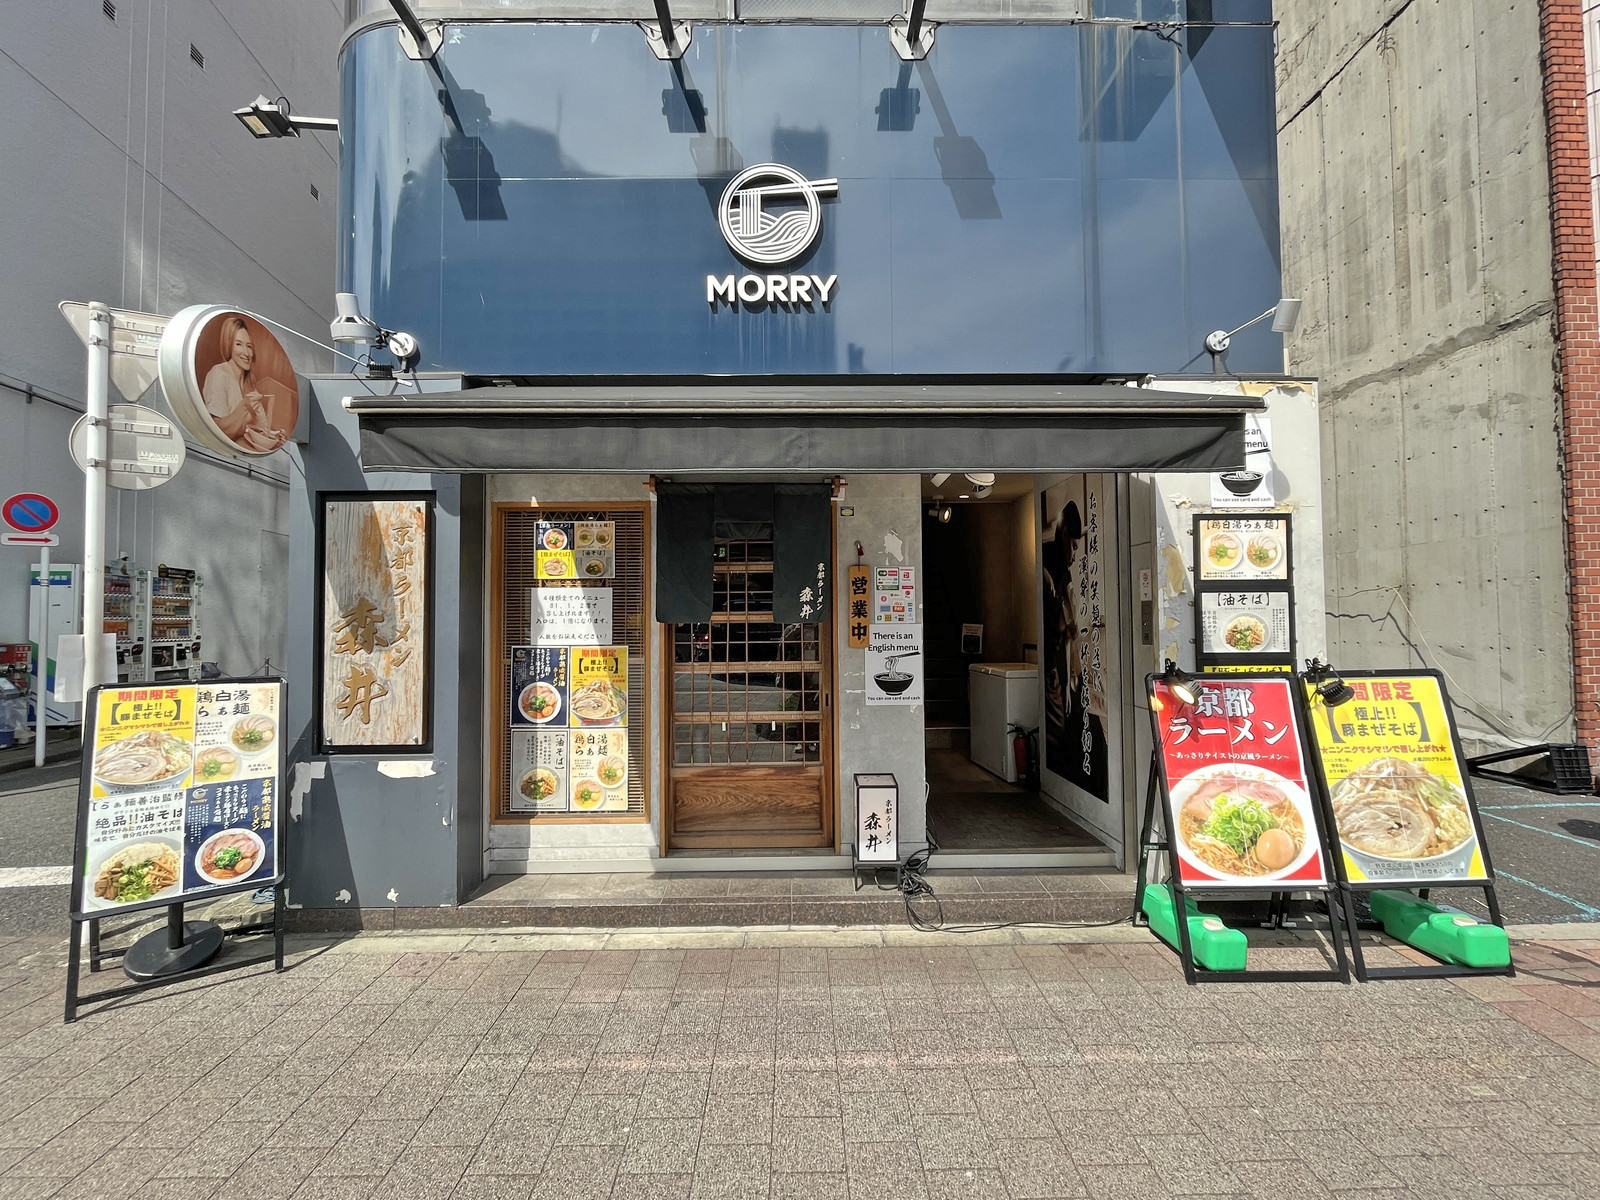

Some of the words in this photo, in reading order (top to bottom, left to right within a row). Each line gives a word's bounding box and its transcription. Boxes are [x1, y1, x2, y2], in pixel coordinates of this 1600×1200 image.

[706, 274, 838, 303] MORRY
[389, 523, 415, 669] 京都ラーメン
[816, 562, 826, 611] 京都ラーメン
[799, 586, 814, 620] 森井
[851, 575, 868, 641] 営業中
[868, 644, 895, 654] English
[873, 632, 895, 640] There
[896, 632, 902, 640] is
[332, 596, 389, 725] 森井
[118, 688, 179, 702] 期間限定
[197, 690, 251, 703] 鶏白湯
[1194, 687, 1255, 718] 京都
[1348, 681, 1415, 701] 間限定
[198, 703, 251, 717] らぁ麺
[1168, 717, 1289, 746] ラーメン
[1341, 722, 1419, 738] 豚まぜそば
[864, 812, 882, 853] 森井
[885, 799, 893, 844] 京都ラーメン
